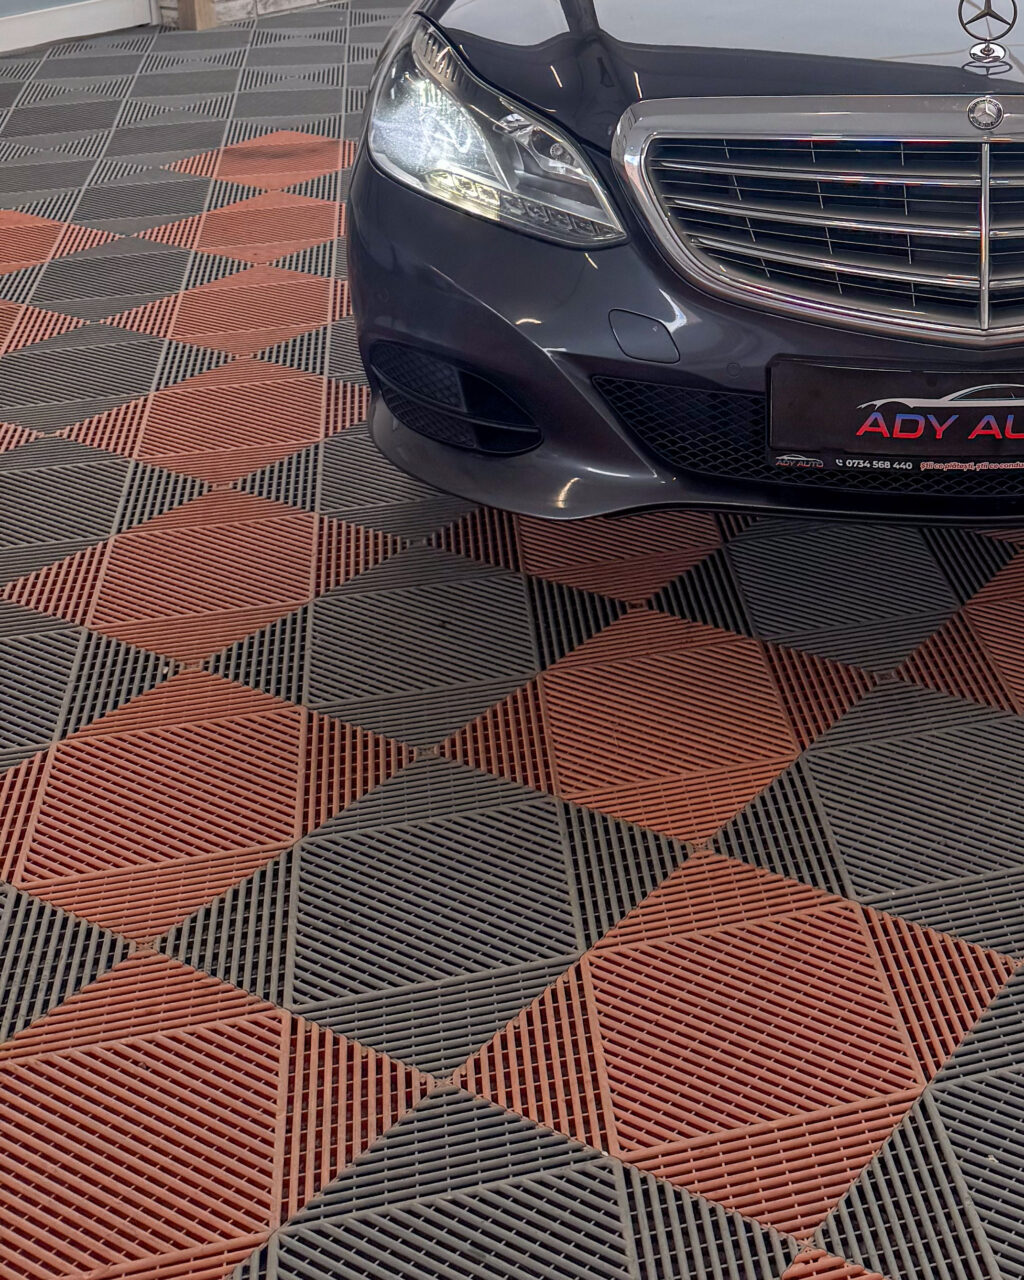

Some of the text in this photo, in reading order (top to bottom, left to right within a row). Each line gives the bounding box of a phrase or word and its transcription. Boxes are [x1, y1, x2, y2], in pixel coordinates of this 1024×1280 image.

[856, 411, 959, 440] ADY
[845, 459, 913, 470] 0734 568 440
